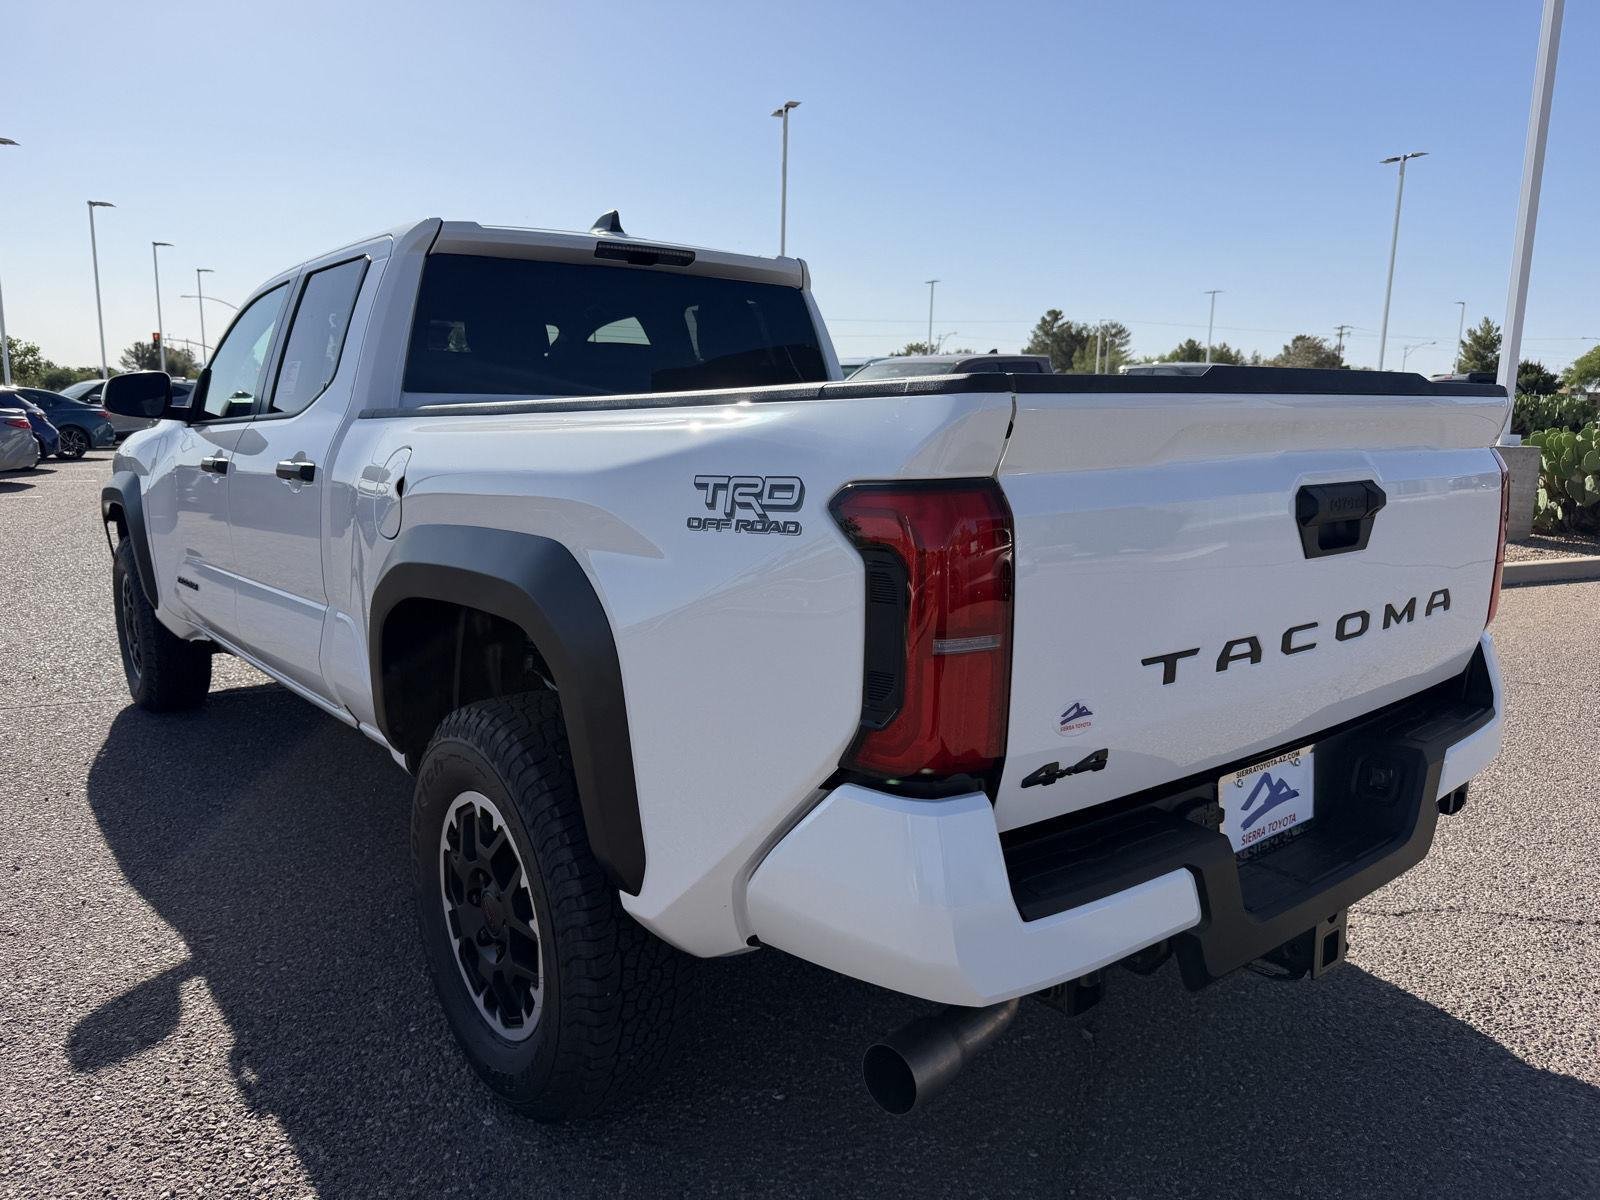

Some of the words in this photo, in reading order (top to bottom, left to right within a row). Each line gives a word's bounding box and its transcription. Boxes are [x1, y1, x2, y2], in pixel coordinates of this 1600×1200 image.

[694, 475, 805, 520] TRD
[687, 517, 732, 532] OFF
[735, 519, 802, 536] ROAD
[1141, 588, 1451, 685] TACOMA
[1236, 751, 1300, 779] SIERRATOYOTA-AZ.COM
[1241, 828, 1266, 846] SIERRA
[1268, 813, 1297, 832] TOYOTA
